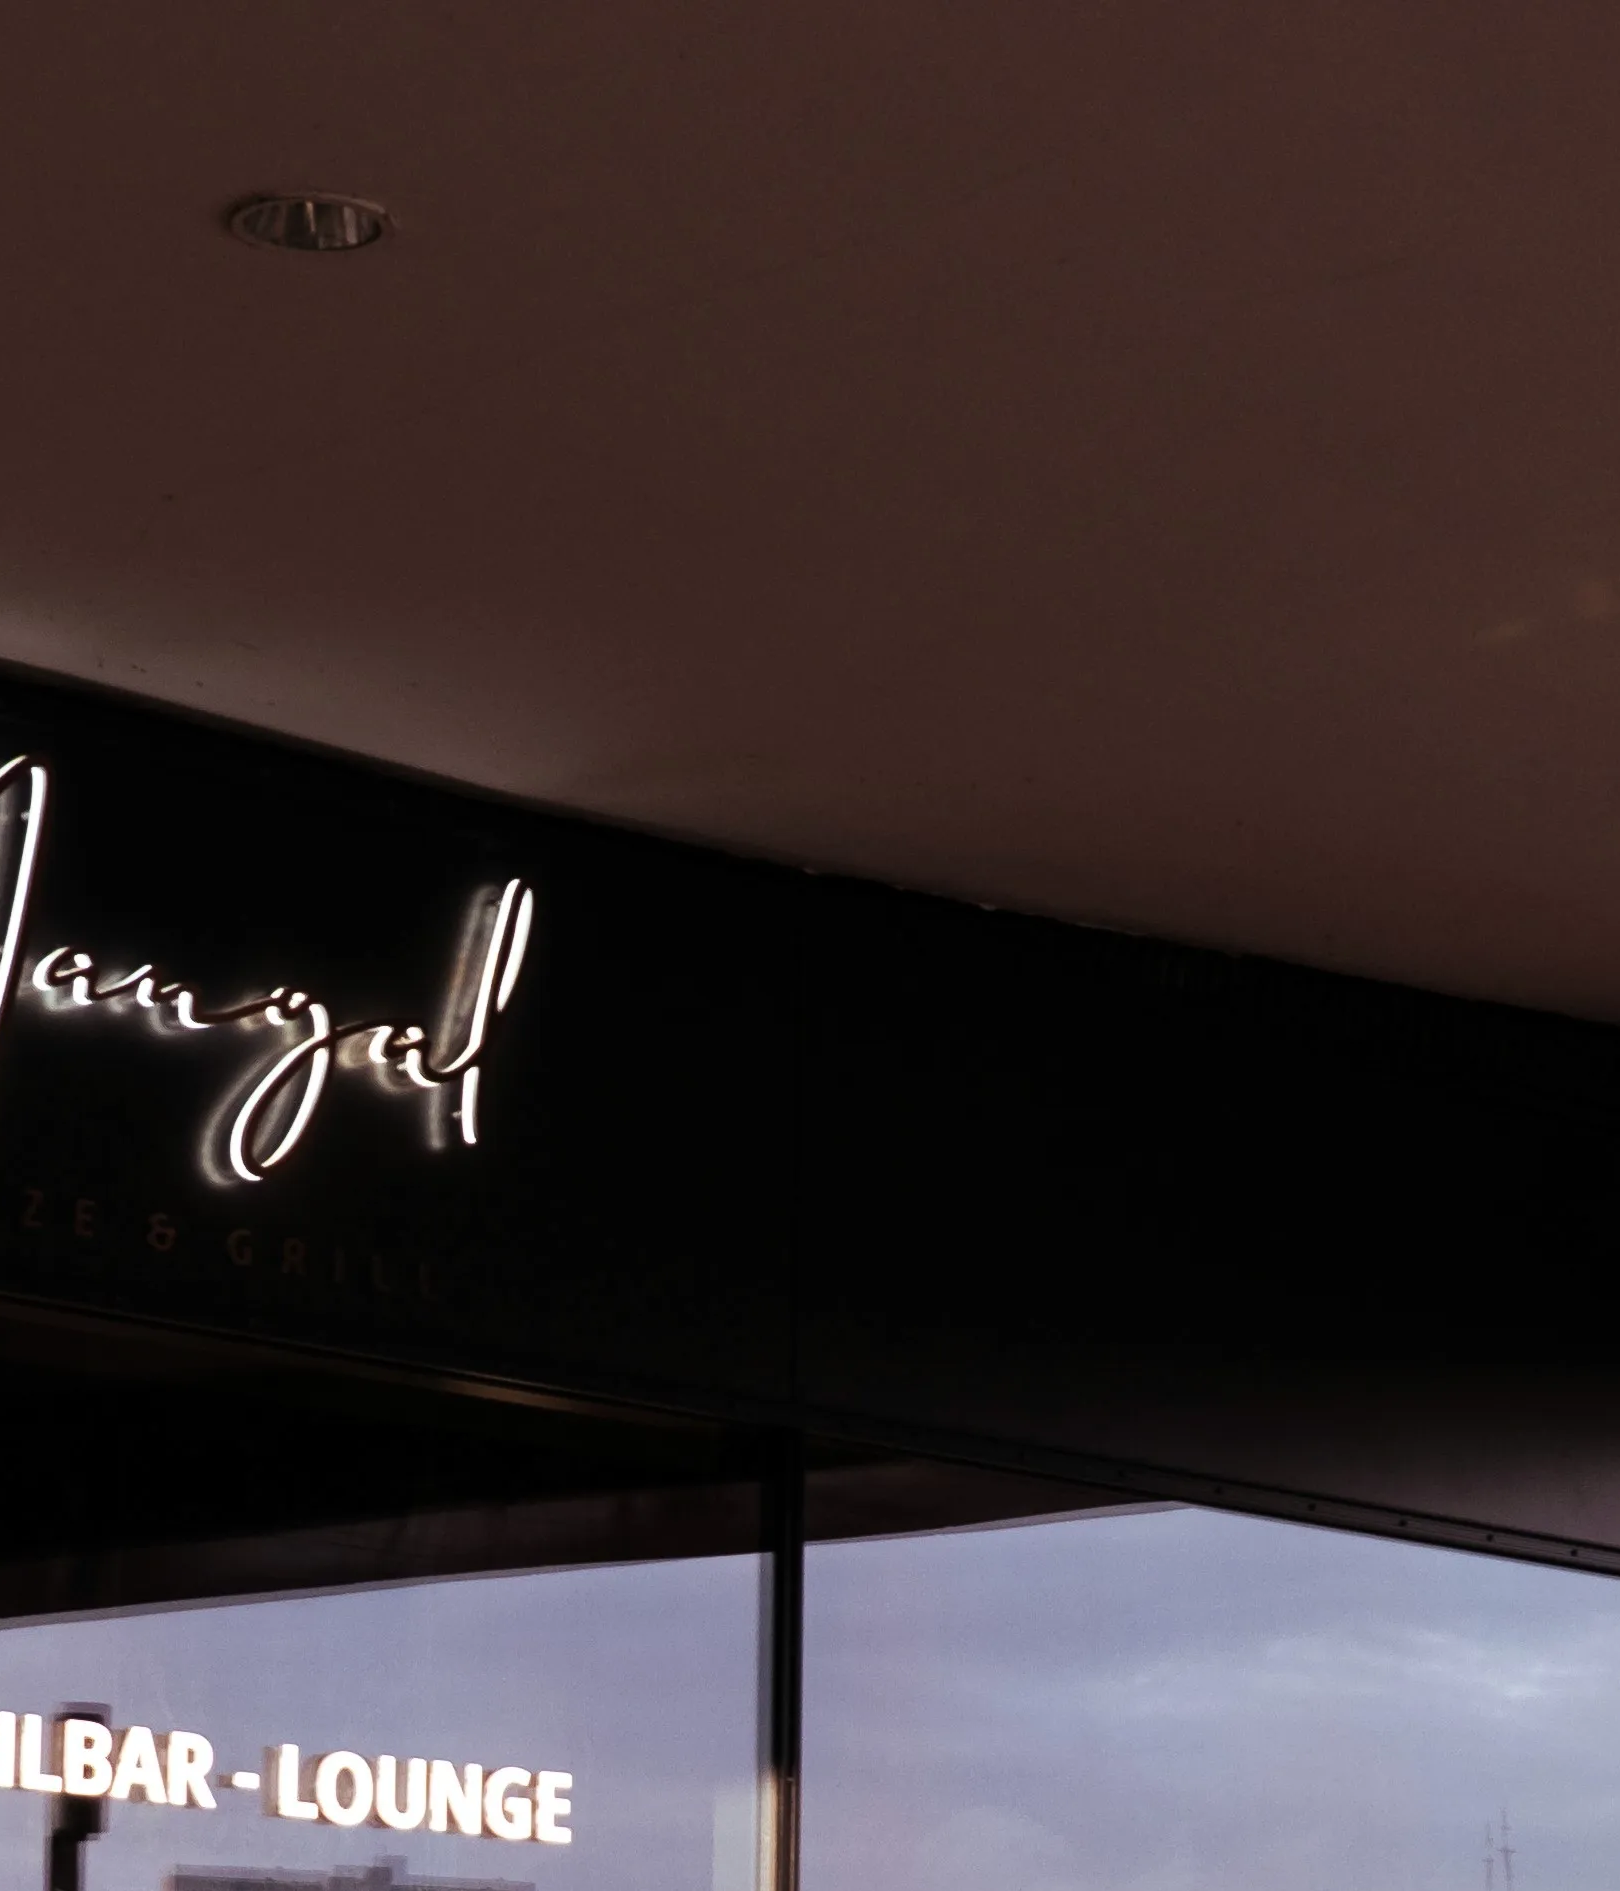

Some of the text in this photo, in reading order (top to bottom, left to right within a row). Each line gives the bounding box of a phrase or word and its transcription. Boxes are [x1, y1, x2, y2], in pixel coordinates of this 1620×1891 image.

[145, 1211, 178, 1252] &
[228, 1229, 442, 1302] GRILL
[272, 1742, 574, 1846] LOUNGE
